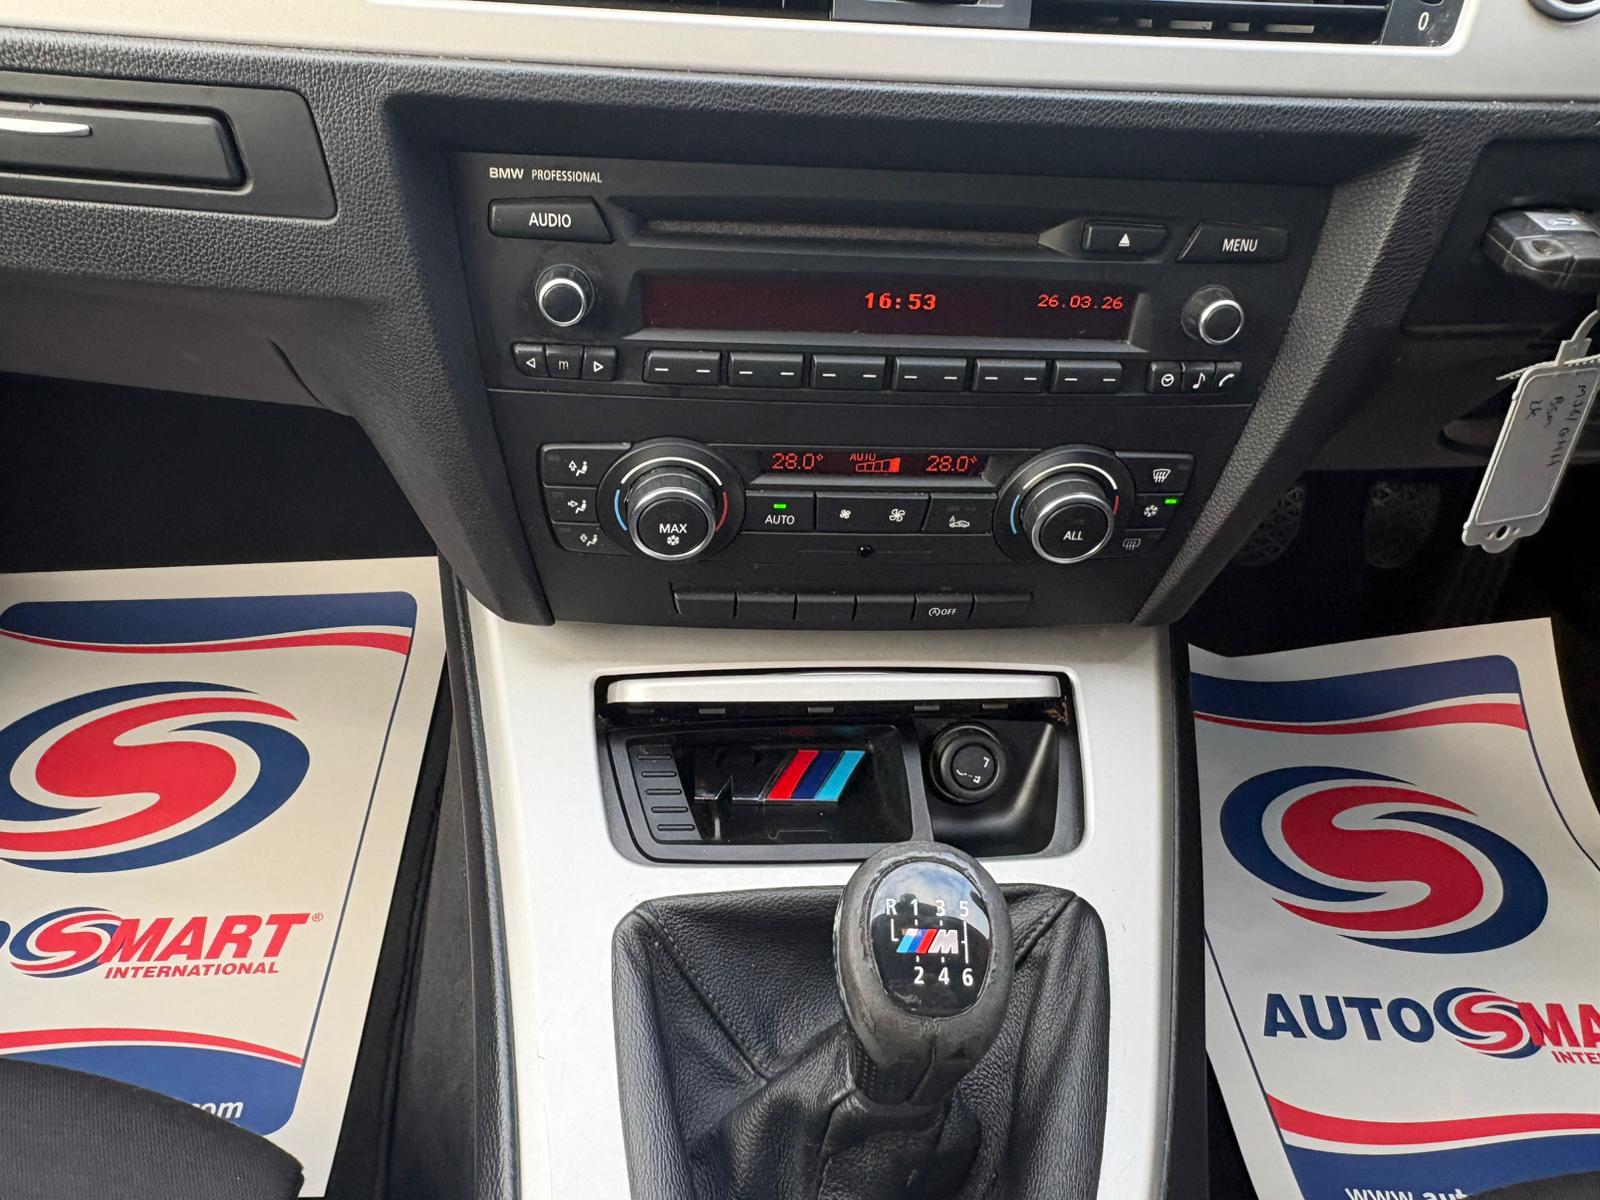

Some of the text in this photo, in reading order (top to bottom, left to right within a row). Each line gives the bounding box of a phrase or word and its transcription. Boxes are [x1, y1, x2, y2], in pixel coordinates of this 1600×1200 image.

[489, 167, 603, 183] BMW PROFESSIONAL
[528, 212, 572, 228] AUDIO
[1222, 238, 1258, 252] MENU
[864, 292, 937, 311] 16:53
[1037, 294, 1124, 310] 26.03.26
[764, 514, 795, 525] AUTO
[659, 523, 687, 534] MAX
[1063, 530, 1083, 541] ALL
[940, 608, 957, 616] OFF
[886, 898, 970, 918] R 1 3 5
[104, 961, 280, 979] INTERNATIONAL
[914, 966, 974, 987] 2 4 6
